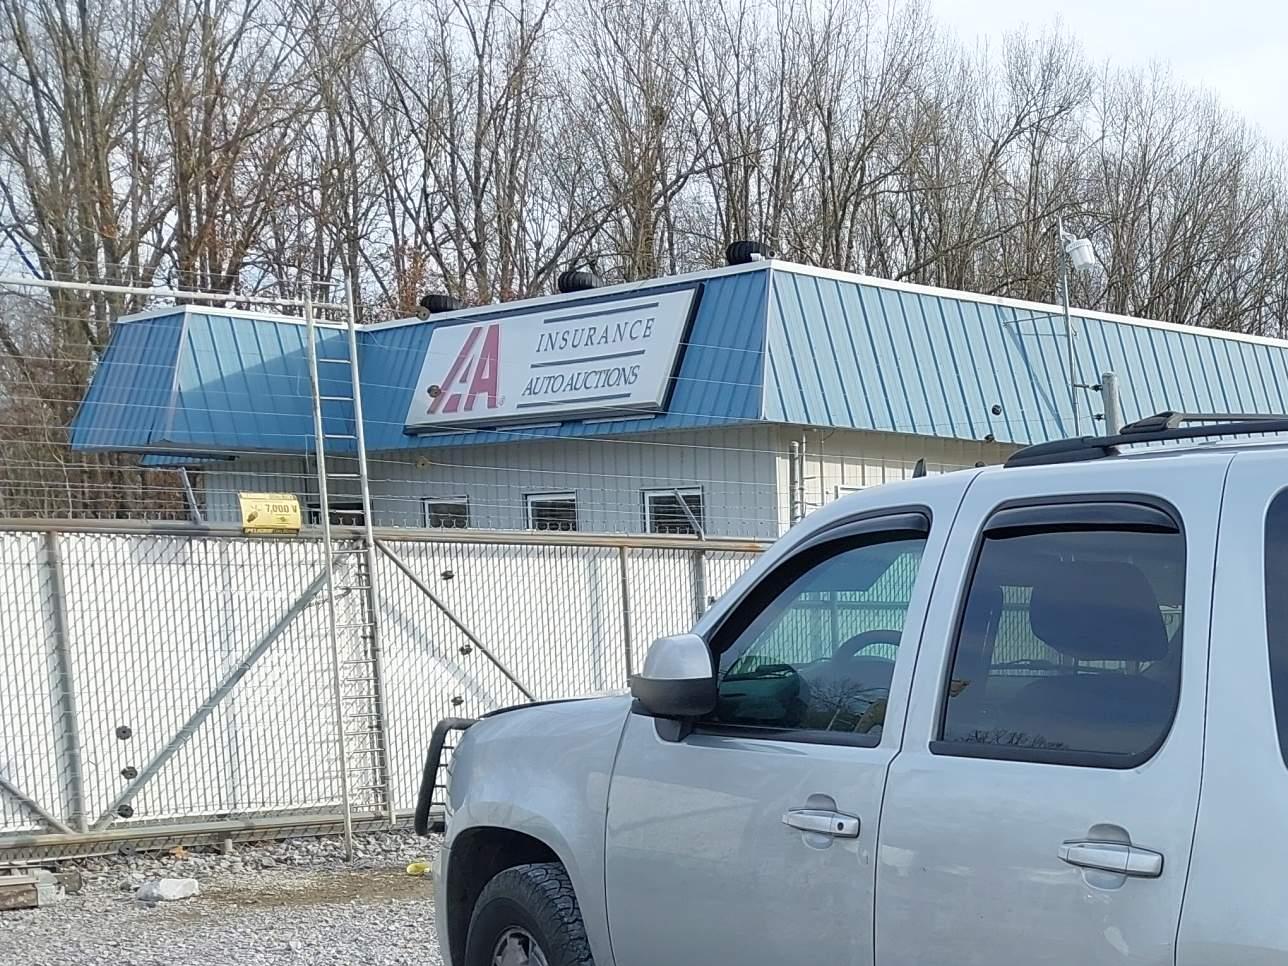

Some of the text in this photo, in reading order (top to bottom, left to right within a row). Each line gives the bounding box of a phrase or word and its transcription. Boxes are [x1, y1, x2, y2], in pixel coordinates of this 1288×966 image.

[535, 317, 656, 353] INSURANCE
[521, 364, 641, 397] AUTO AUCTIONS
